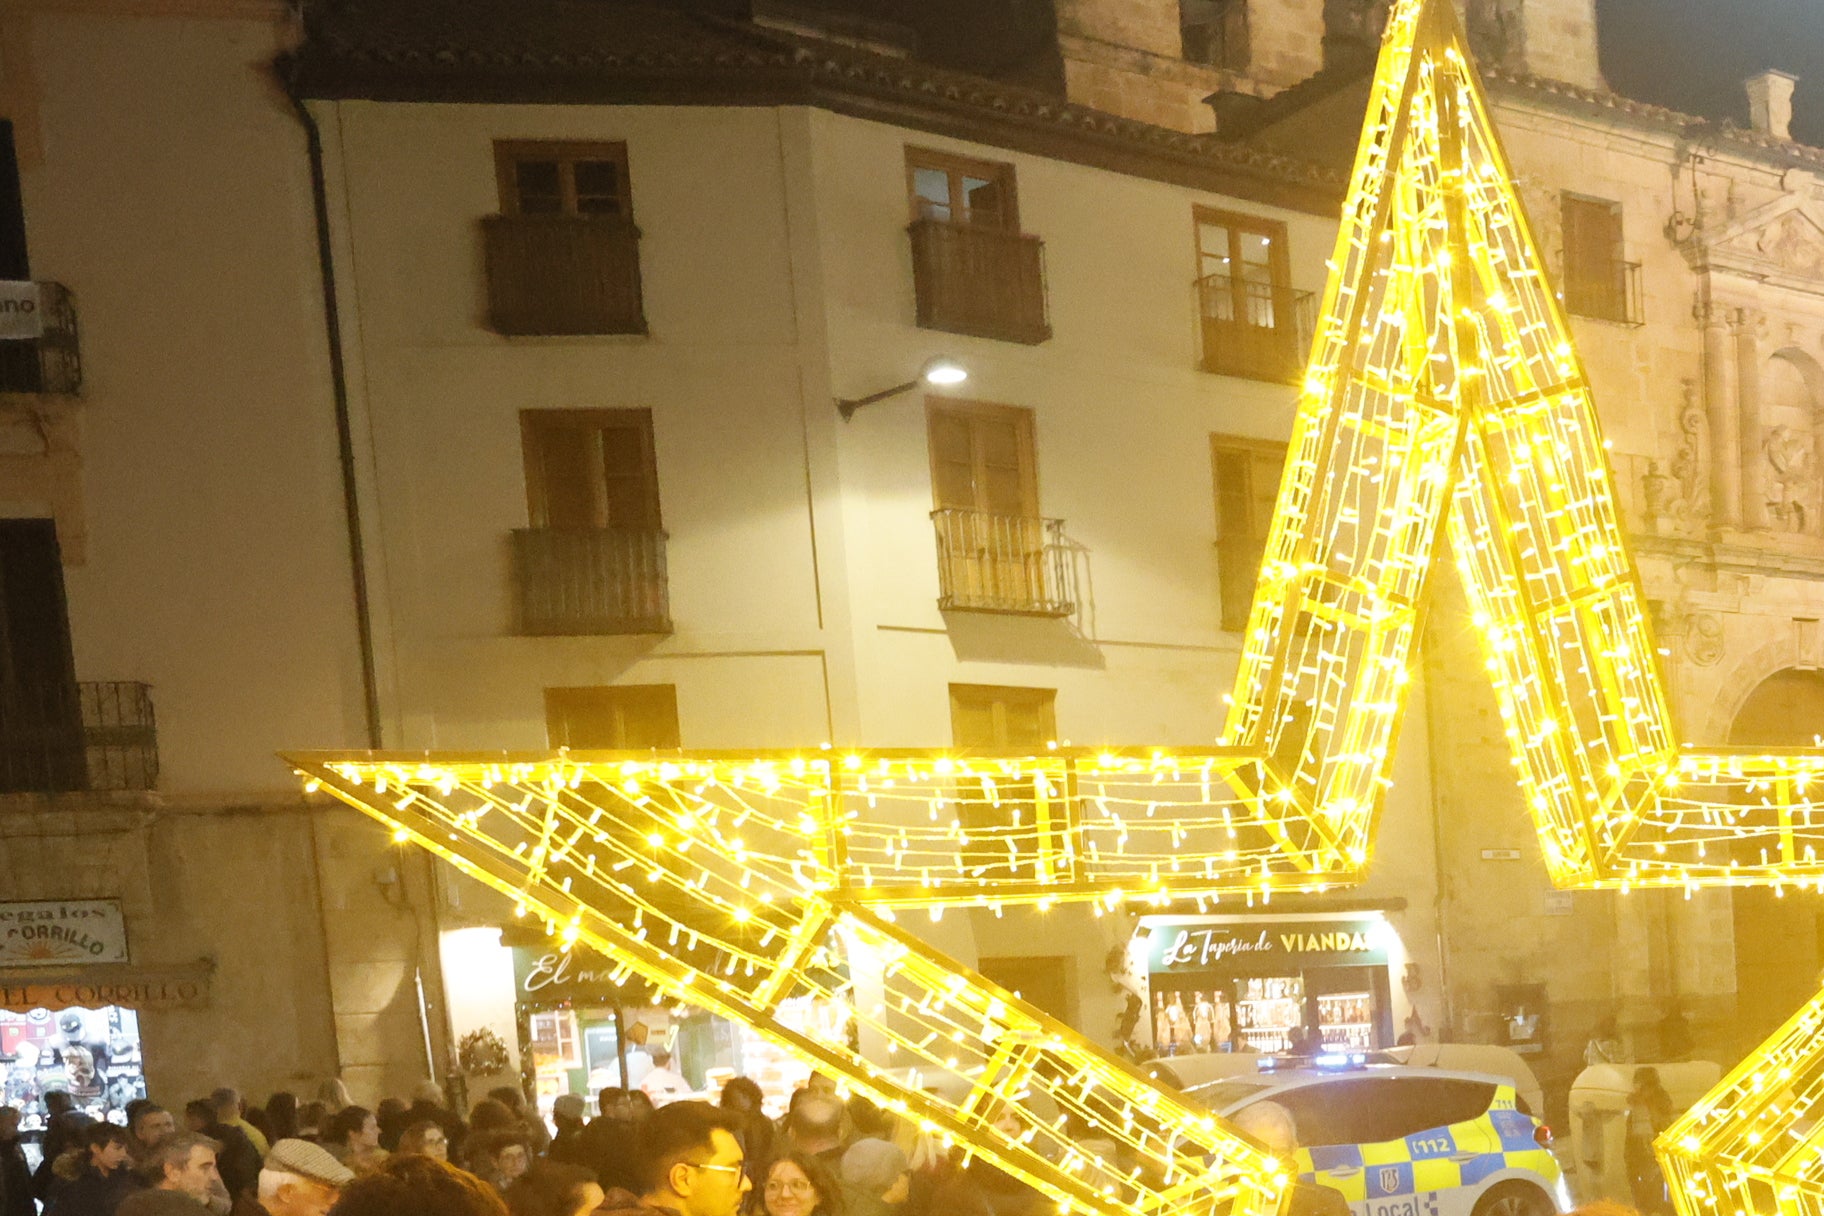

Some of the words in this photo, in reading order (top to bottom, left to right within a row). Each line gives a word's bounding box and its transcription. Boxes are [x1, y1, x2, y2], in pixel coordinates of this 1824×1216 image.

[7, 924, 105, 956] CORRILLO
[1161, 929, 1198, 966] La
[1254, 929, 1273, 952] de
[523, 953, 573, 993] El
[55, 983, 198, 1006] CORRILLO
[1417, 1137, 1450, 1154] 112
